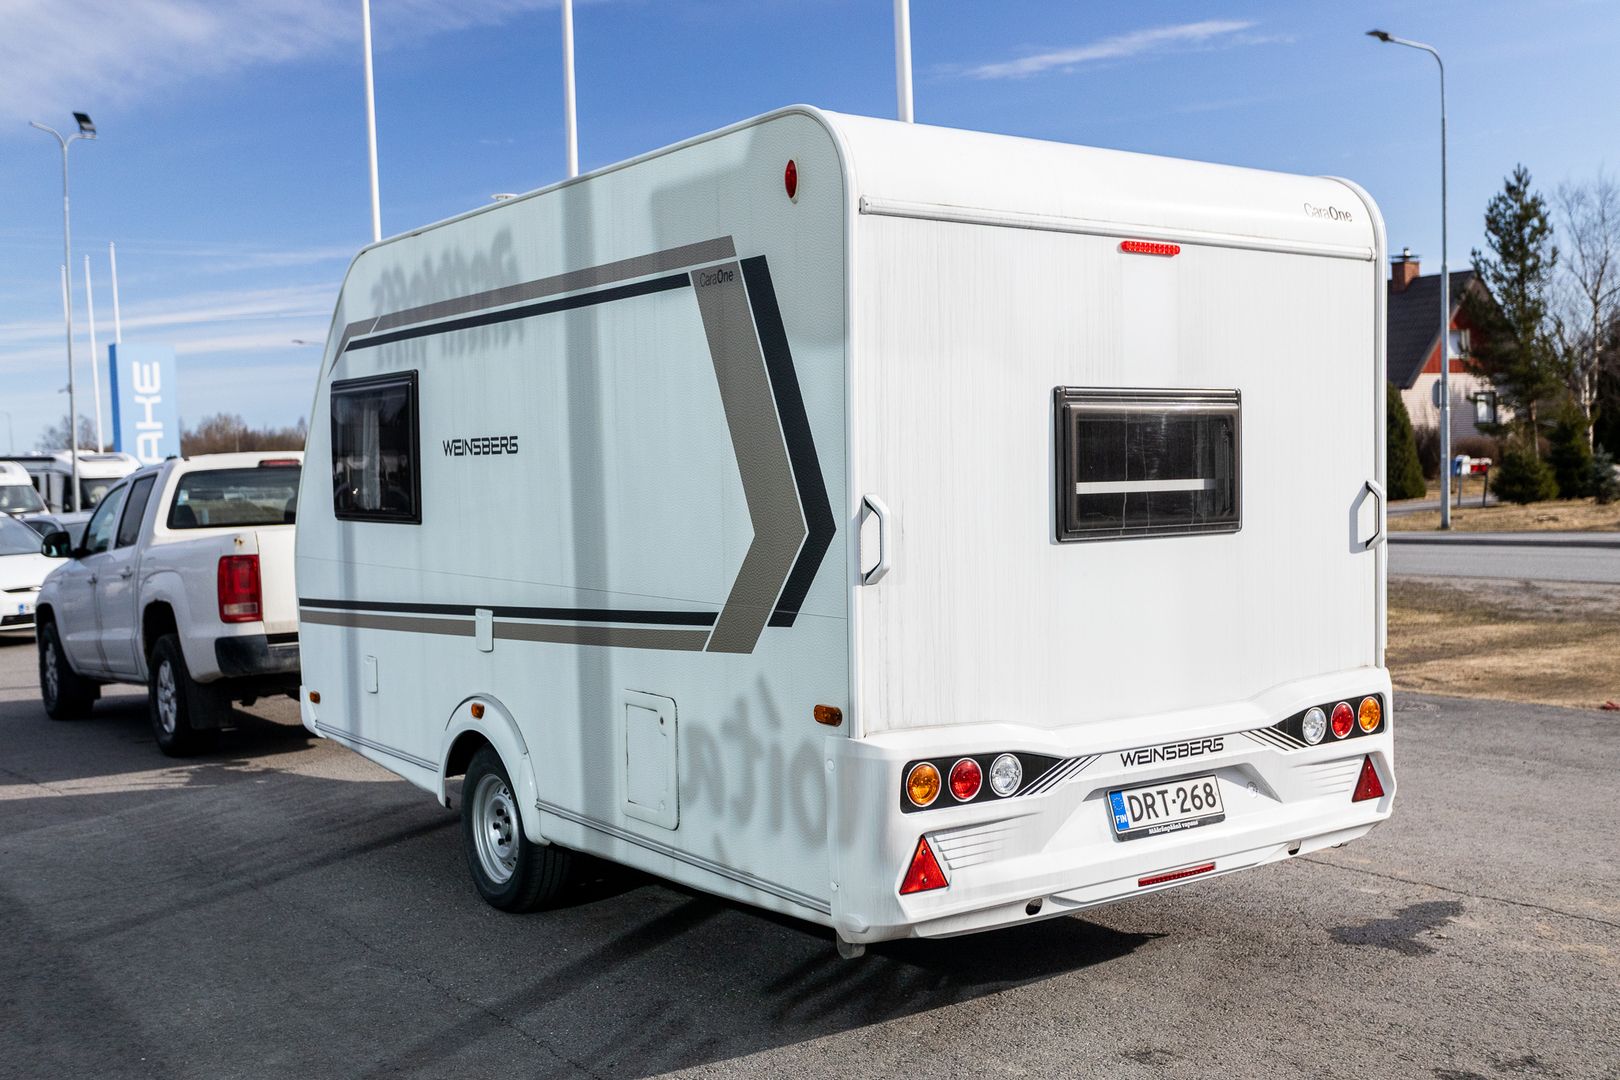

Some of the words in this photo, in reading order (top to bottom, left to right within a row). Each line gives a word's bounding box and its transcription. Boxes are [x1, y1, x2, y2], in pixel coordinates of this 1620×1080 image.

[1303, 202, 1353, 223] CaraOne
[700, 268, 734, 287] CaraOne
[442, 435, 519, 457] WEINSBERG
[1120, 737, 1224, 768] WEINSBERG
[1115, 814, 1128, 825] FIN
[1126, 782, 1217, 823] DRT-268
